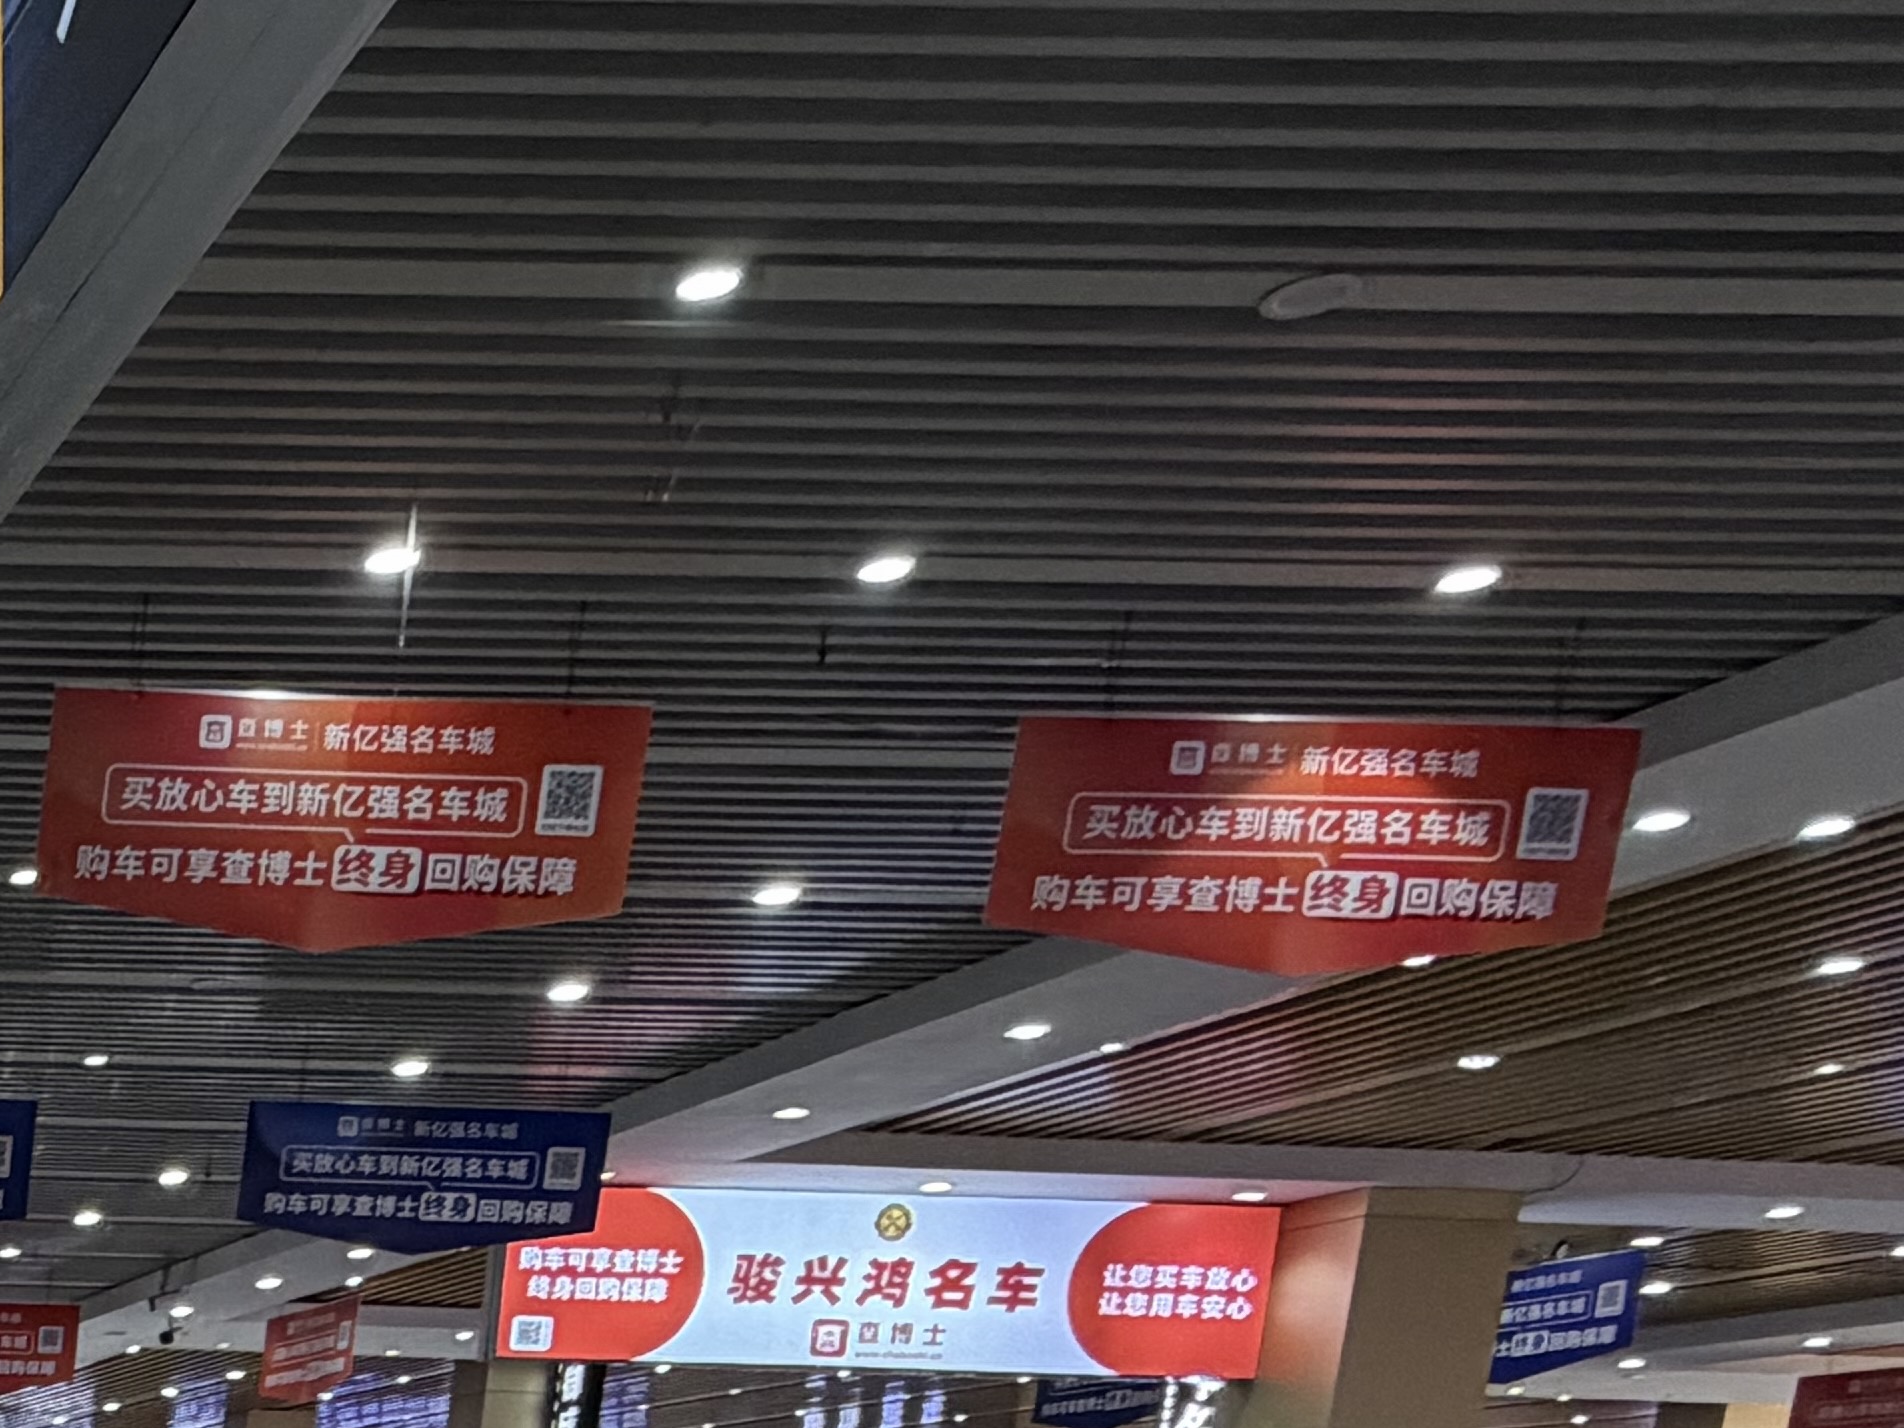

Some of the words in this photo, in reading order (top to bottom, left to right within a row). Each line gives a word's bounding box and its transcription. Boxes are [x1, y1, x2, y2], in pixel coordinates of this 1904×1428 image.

[323, 723, 496, 756] 新亿强名车城
[1300, 745, 1479, 779] 新亿强名车城
[120, 776, 510, 824] 买放心车到新亿强名车城
[1084, 804, 1491, 848] 买放心车到新亿强名车城
[75, 845, 578, 897] 购车可享查博士终身回购保障
[1031, 870, 1559, 921] 购车可享查博士终身回购保障
[292, 1153, 530, 1181] 买放心车到新亿强名车城
[263, 1192, 574, 1225] 购车可享查博士终身回购保障
[519, 1247, 683, 1274] 购车可享查博士
[527, 1275, 669, 1304] 终身回购保障
[726, 1252, 1045, 1313] 骏兴鸿名车
[1103, 1263, 1258, 1293] 让您买车放心
[1097, 1291, 1253, 1320] 让您用车安心
